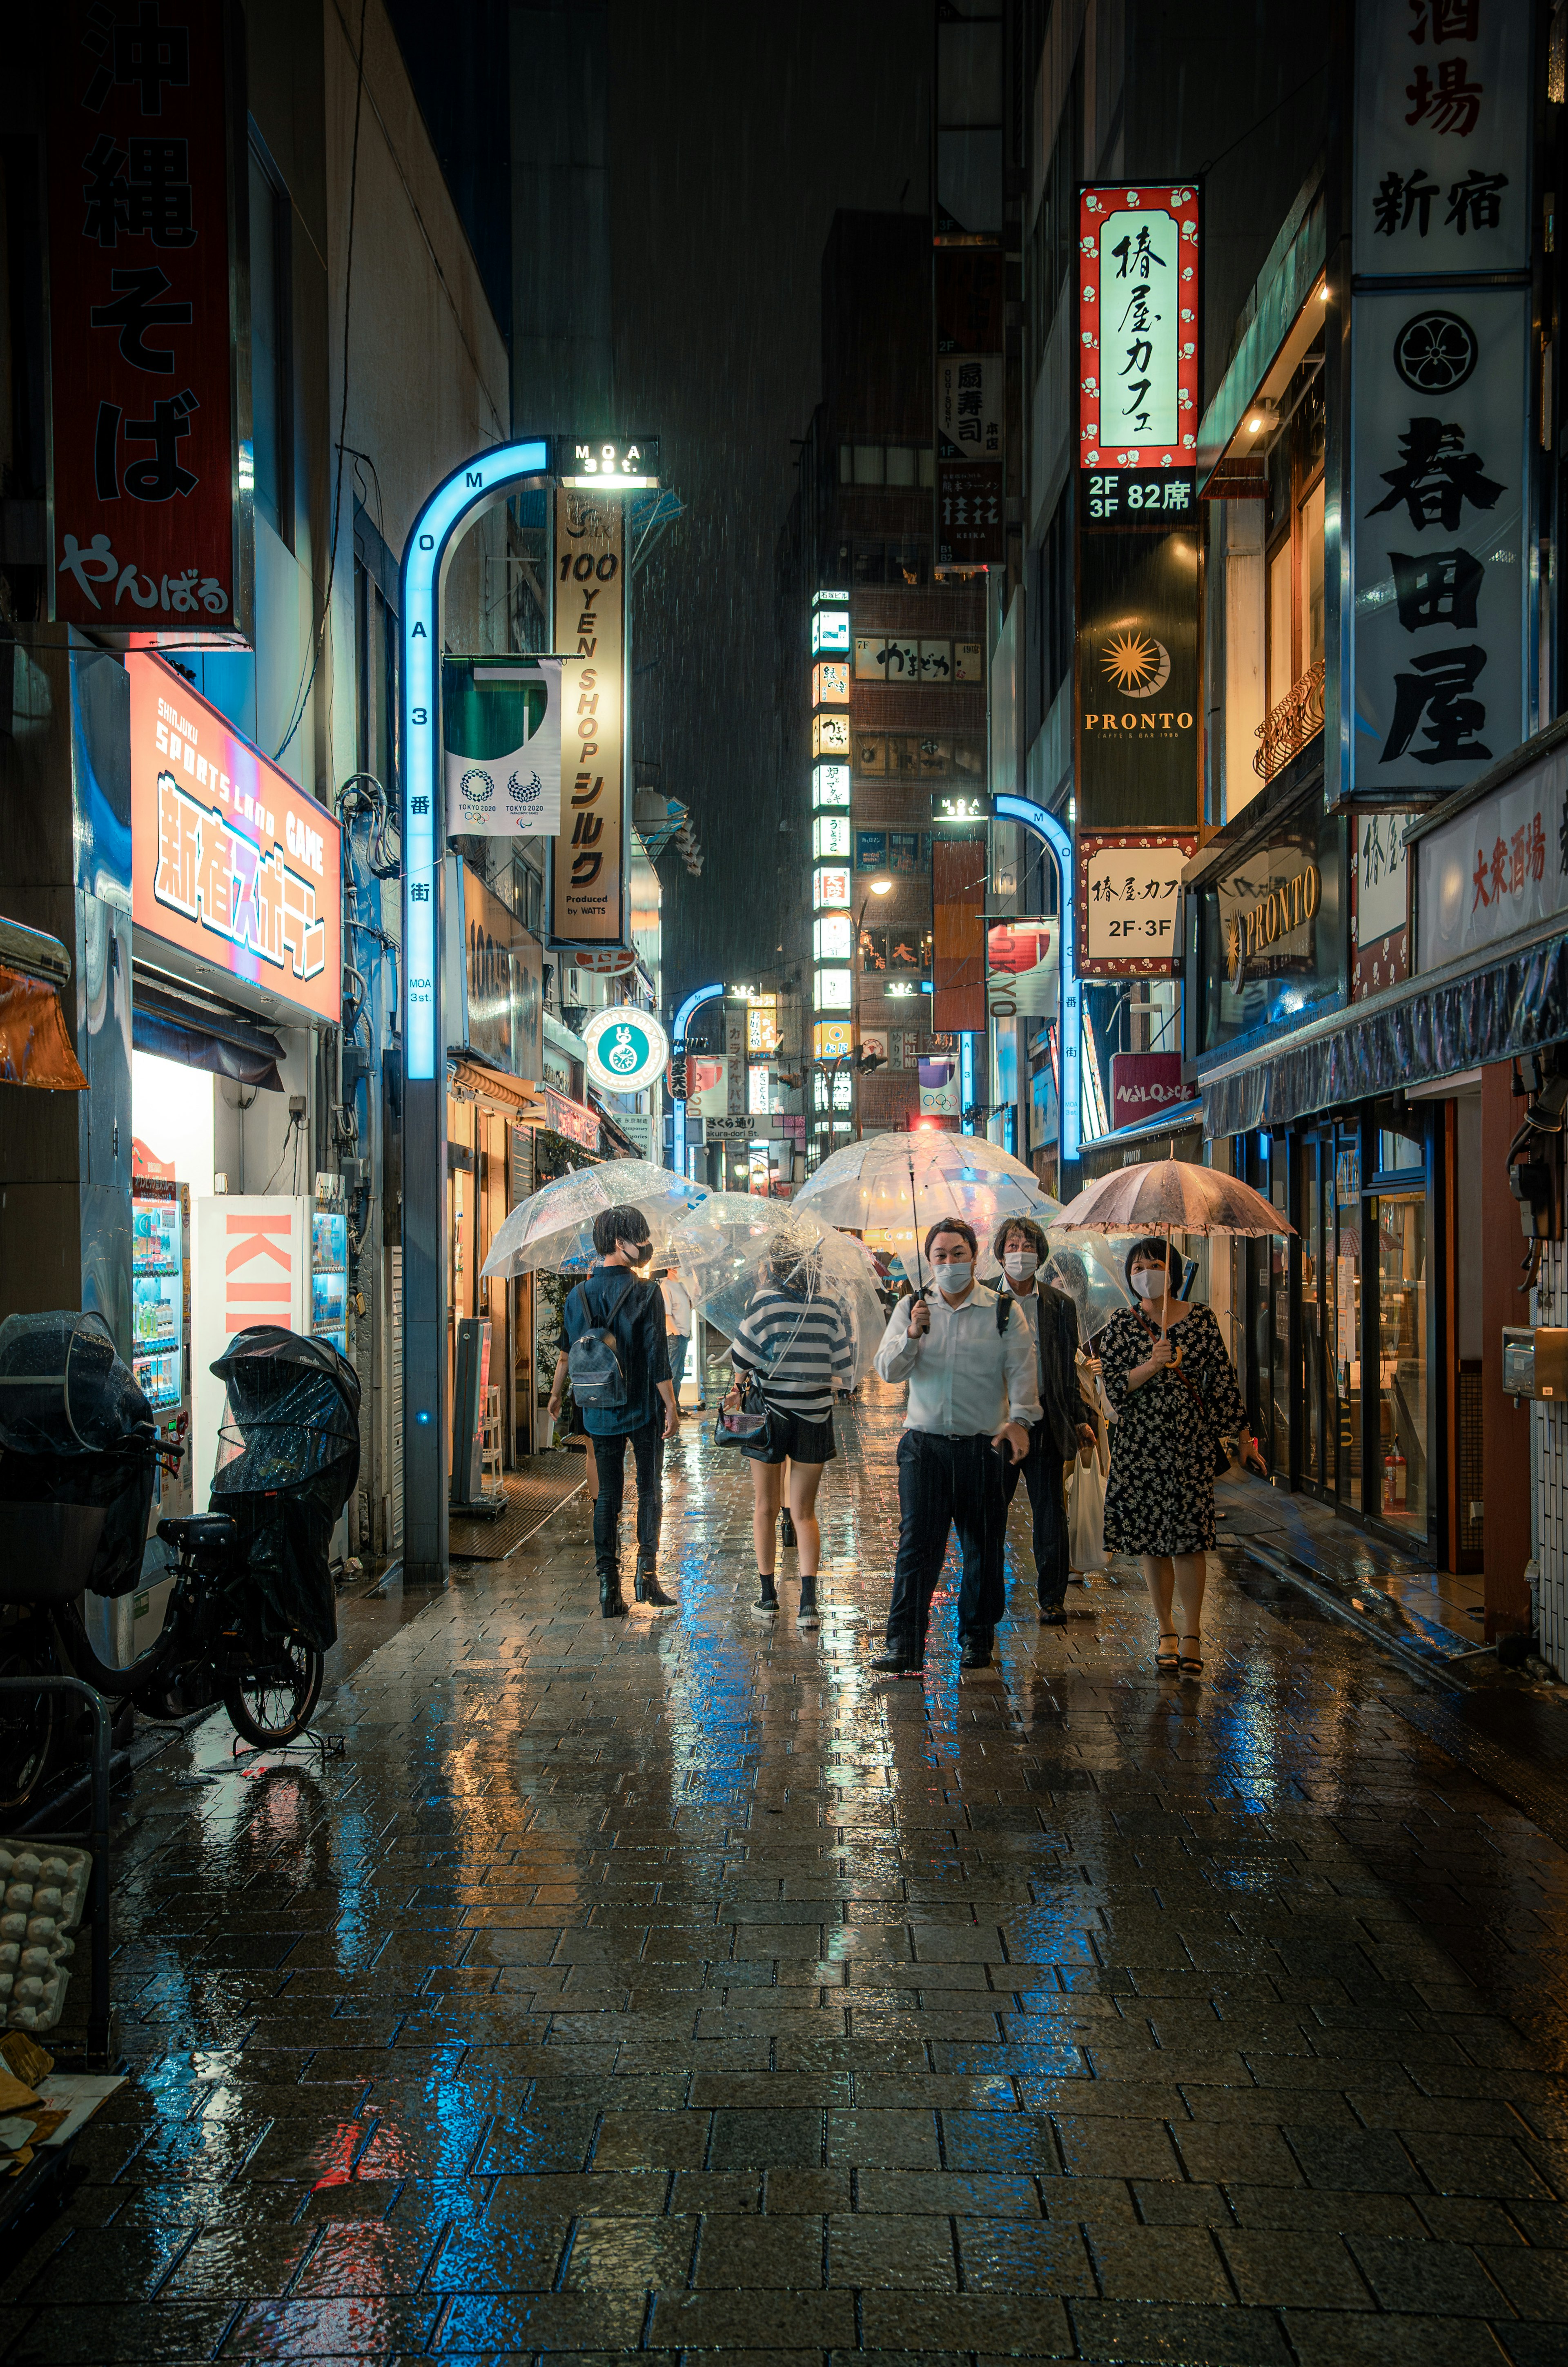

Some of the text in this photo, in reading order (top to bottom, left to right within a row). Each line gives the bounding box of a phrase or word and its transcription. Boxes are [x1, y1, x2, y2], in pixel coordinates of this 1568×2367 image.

[1405, 0, 1483, 137] 酒場
[1372, 169, 1510, 238] 新宿
[938, 220, 954, 230] 3F
[82, 2, 200, 501] 沖縄そば
[938, 341, 954, 352] 2F
[1111, 225, 1167, 432] 椿屋カフェ
[958, 363, 982, 443] 扇寿司
[575, 445, 641, 459] MOA
[940, 446, 955, 457] 1F
[986, 421, 999, 451] 本店
[1089, 476, 1119, 495] 2F
[1128, 481, 1191, 510] 82席
[1089, 499, 1119, 518] 3F
[940, 545, 952, 553] B1
[58, 534, 229, 614] やんばる
[560, 553, 619, 582] 100
[1364, 417, 1509, 766] 春田屋
[577, 588, 601, 659] YEN
[857, 641, 870, 649] 7F
[876, 642, 962, 678] かまどか
[158, 696, 198, 746] SHINJUKU
[577, 669, 599, 763] SHOP
[822, 718, 847, 746] かまどか
[1085, 712, 1193, 730] PRONTO
[156, 720, 325, 877] SPORTS LAND GAME
[826, 767, 843, 804] 炉とマタギ
[942, 798, 980, 807] MOA
[570, 772, 604, 889] シルク
[1363, 815, 1411, 891] 椿屋
[1472, 811, 1546, 913] 大衆酒場
[566, 895, 608, 904] Produced
[826, 876, 844, 899] 大陸
[567, 907, 606, 916] by WATTS
[1246, 865, 1316, 957] PRONTO
[410, 979, 431, 988] MOA
[989, 937, 1017, 1017] OKYO
[593, 1012, 631, 1034] STORY
[632, 1013, 661, 1048] TOKYO
[824, 1042, 849, 1054] 松屋
[587, 1048, 608, 1081] Watches
[607, 1075, 644, 1087] Jewelry
[706, 1117, 755, 1129] さくら通り
[226, 1214, 292, 1333] KI
